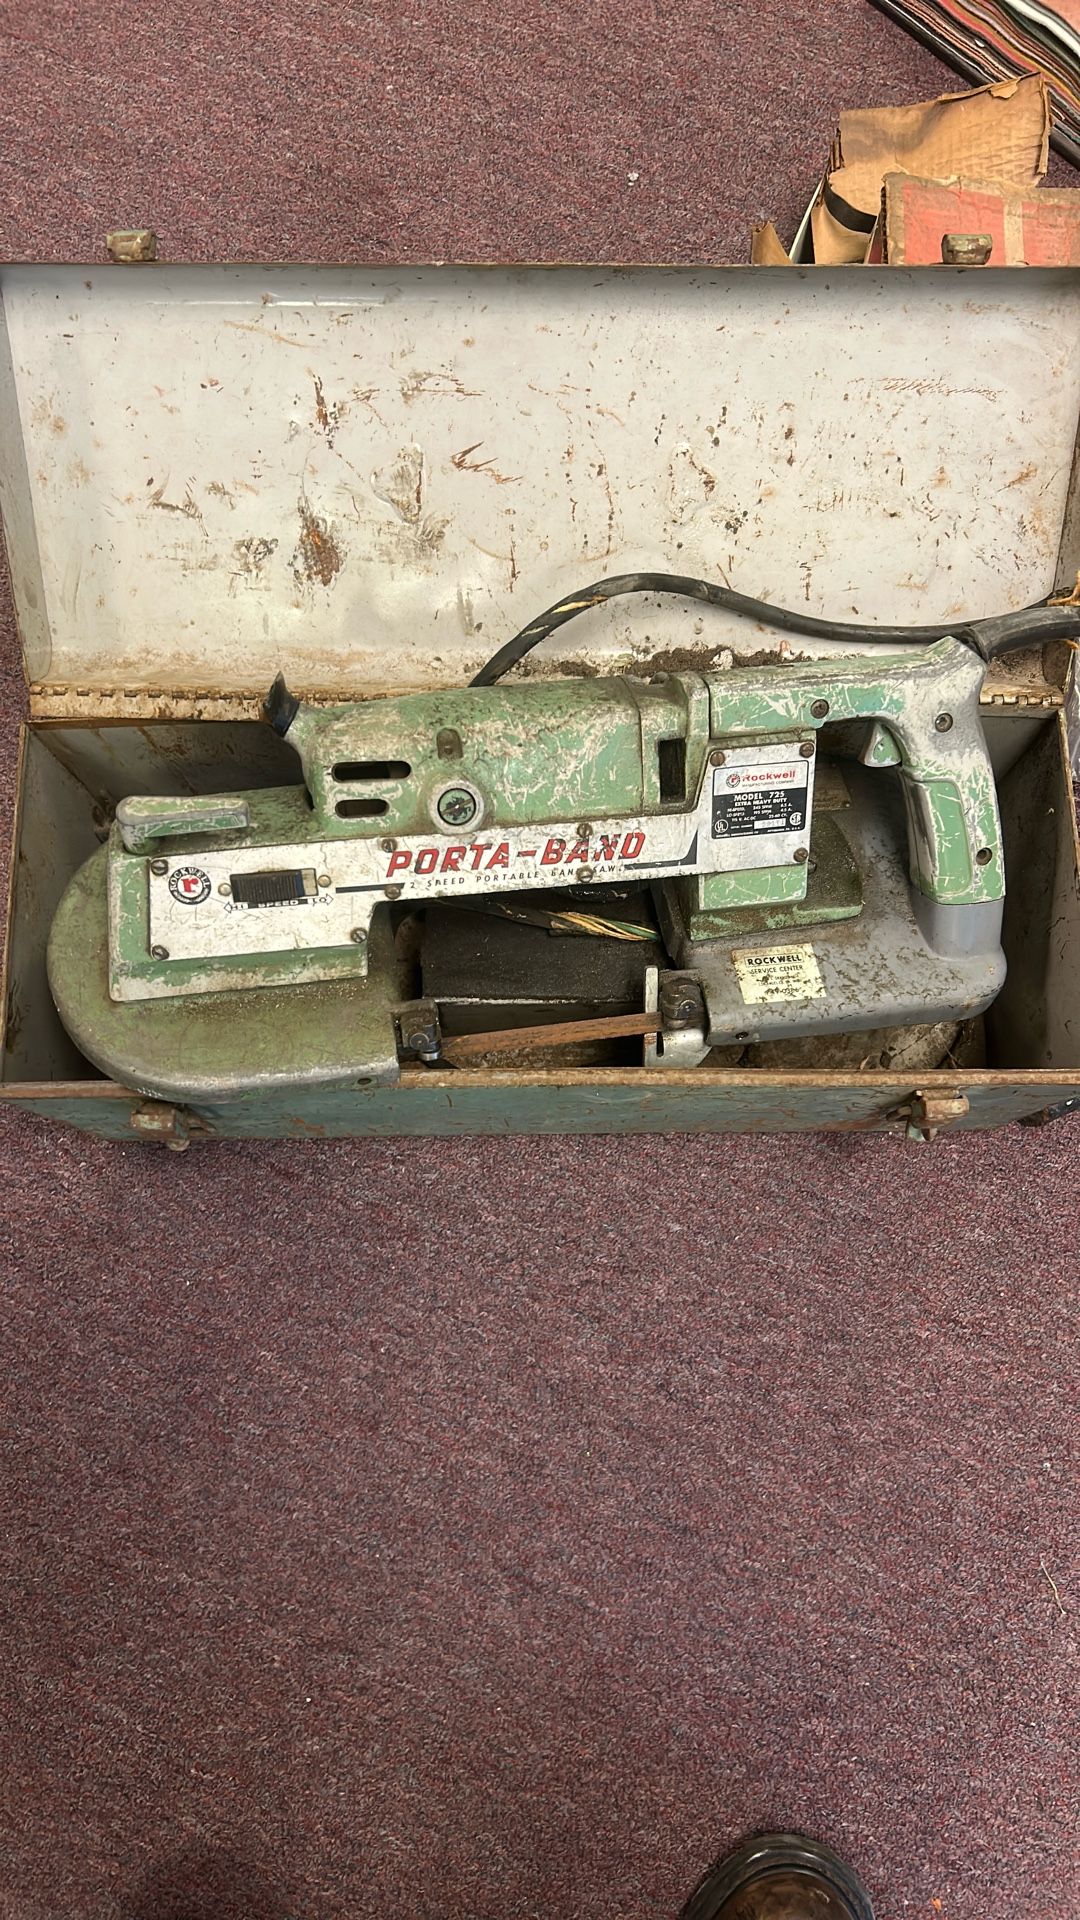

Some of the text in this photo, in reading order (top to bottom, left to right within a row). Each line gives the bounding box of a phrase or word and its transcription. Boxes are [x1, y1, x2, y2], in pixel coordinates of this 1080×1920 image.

[742, 770, 796, 782] Rockwell
[734, 793, 763, 802] MODEL
[169, 867, 210, 892] ROCKWELL
[427, 877, 465, 887] SPEED
[476, 871, 539, 883] PORTABLE
[551, 867, 581, 877] BAN
[258, 899, 299, 908] SPEED
[748, 955, 802, 965] ROCKWELL
[750, 964, 804, 975] SERVICE CENTER
